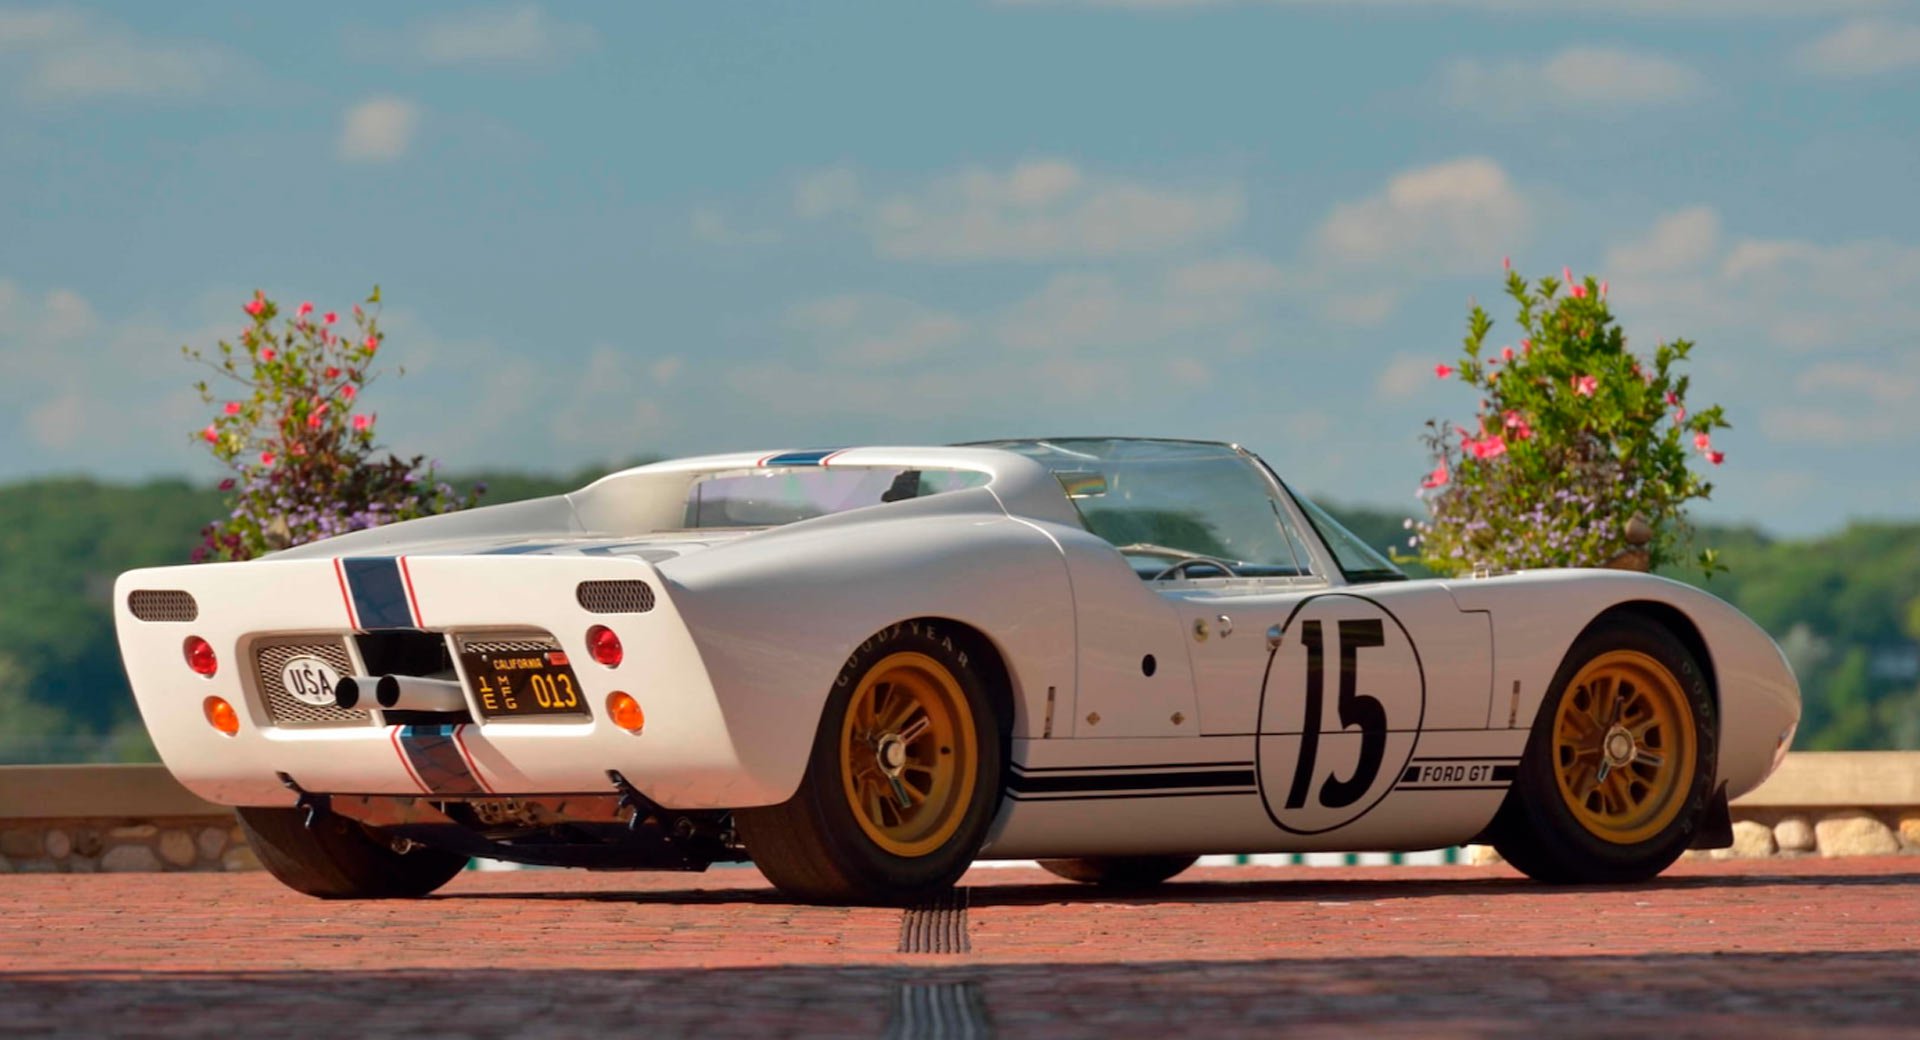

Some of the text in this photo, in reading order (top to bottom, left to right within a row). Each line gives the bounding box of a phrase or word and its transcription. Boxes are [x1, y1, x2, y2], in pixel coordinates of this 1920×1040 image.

[492, 657, 544, 671] CALIFORNIA
[835, 621, 969, 688] GOODYEAR
[289, 668, 335, 695] USA
[530, 672, 578, 709] 013
[1284, 618, 1388, 809] 15
[1421, 764, 1490, 782] FORD GT
